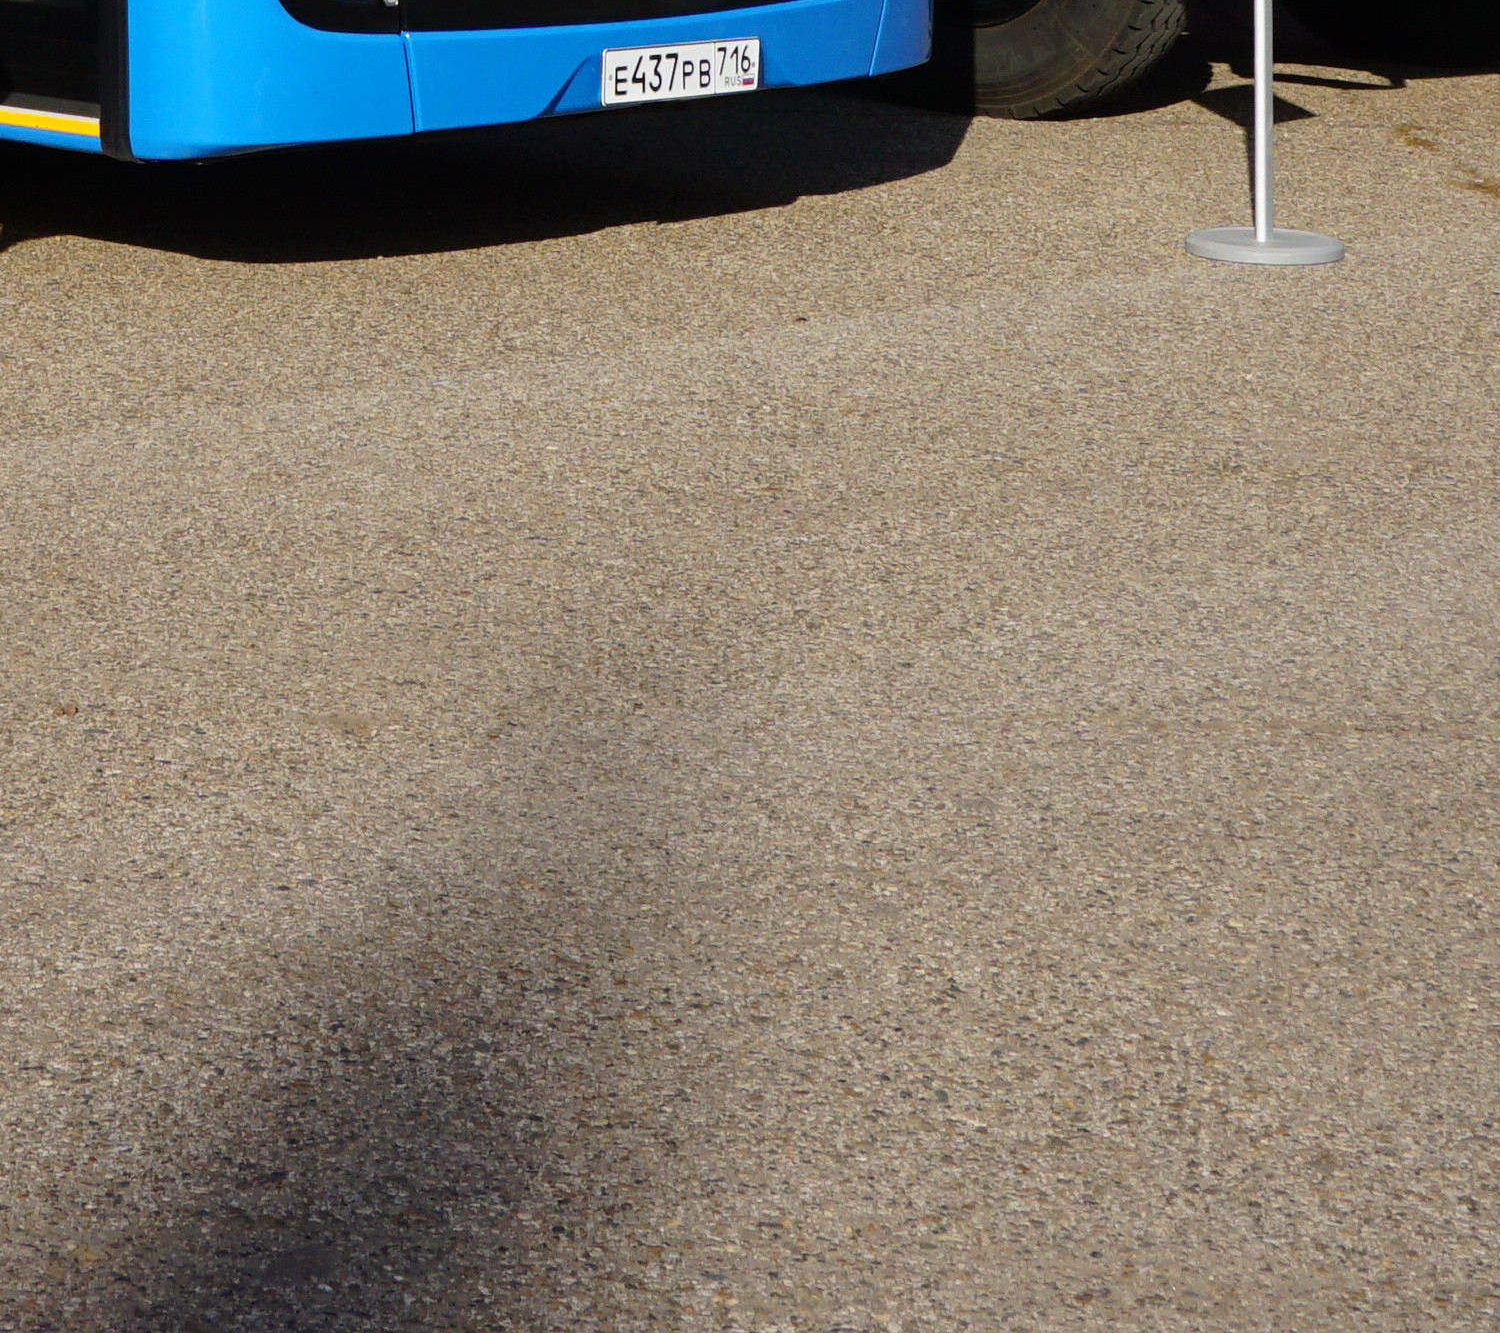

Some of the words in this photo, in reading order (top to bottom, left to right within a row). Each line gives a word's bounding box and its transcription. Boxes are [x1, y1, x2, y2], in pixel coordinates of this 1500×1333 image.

[614, 52, 711, 96] Е437РВ
[717, 44, 751, 77] 716
[724, 75, 742, 87] RUS
